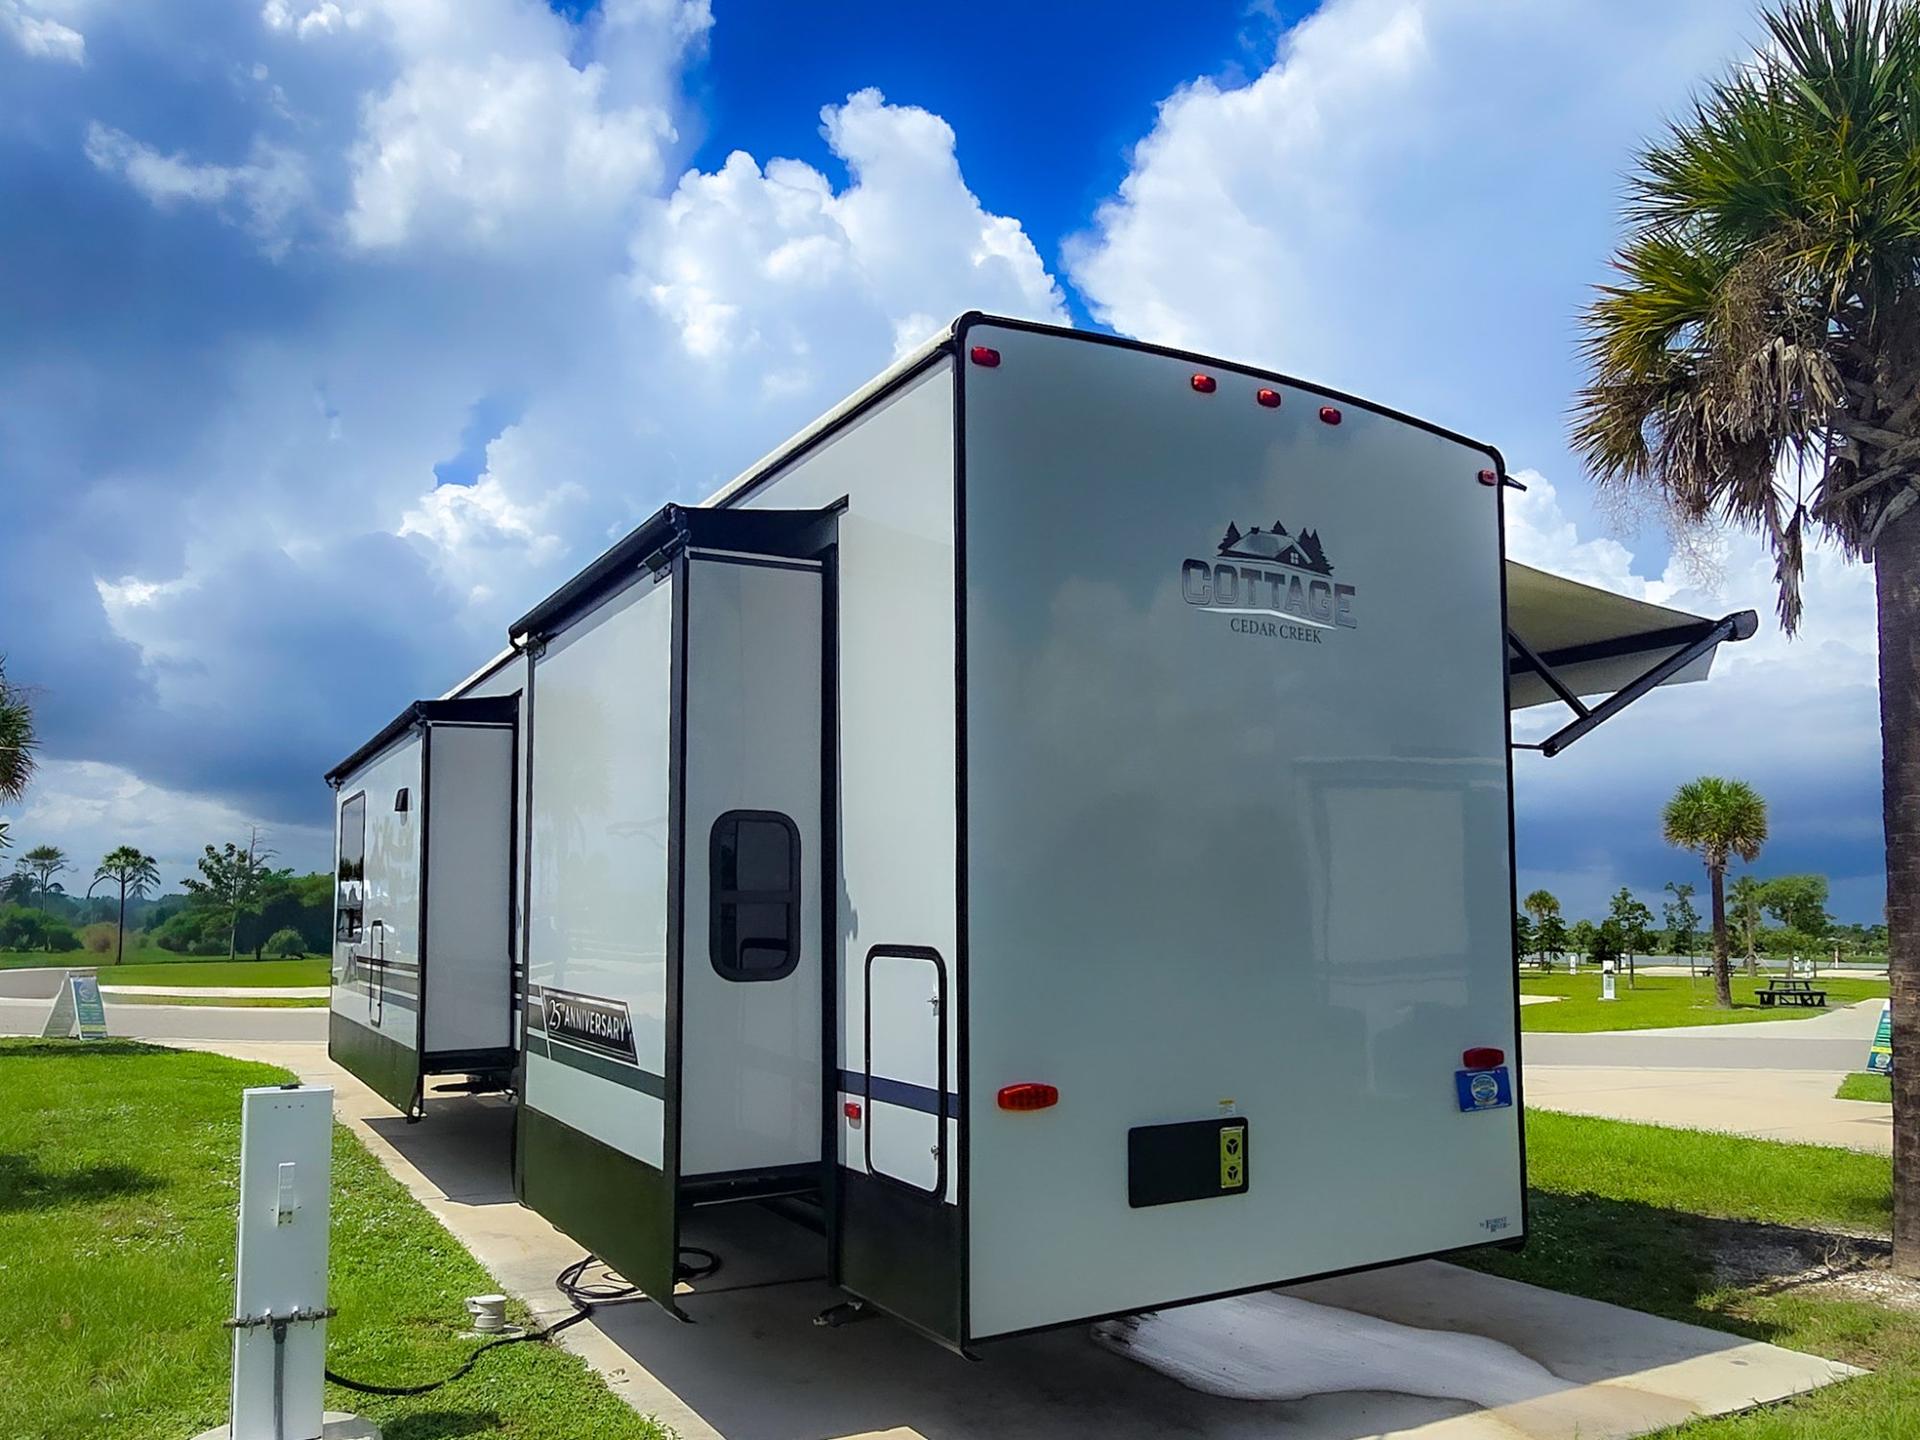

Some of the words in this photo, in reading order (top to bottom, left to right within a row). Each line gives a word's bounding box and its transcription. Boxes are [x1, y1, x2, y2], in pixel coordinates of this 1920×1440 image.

[1181, 558, 1357, 629] COTTAGE
[1230, 617, 1277, 639] CEDAR
[1279, 624, 1323, 645] CREEK
[564, 1005, 626, 1042] ANNIVERSARY
